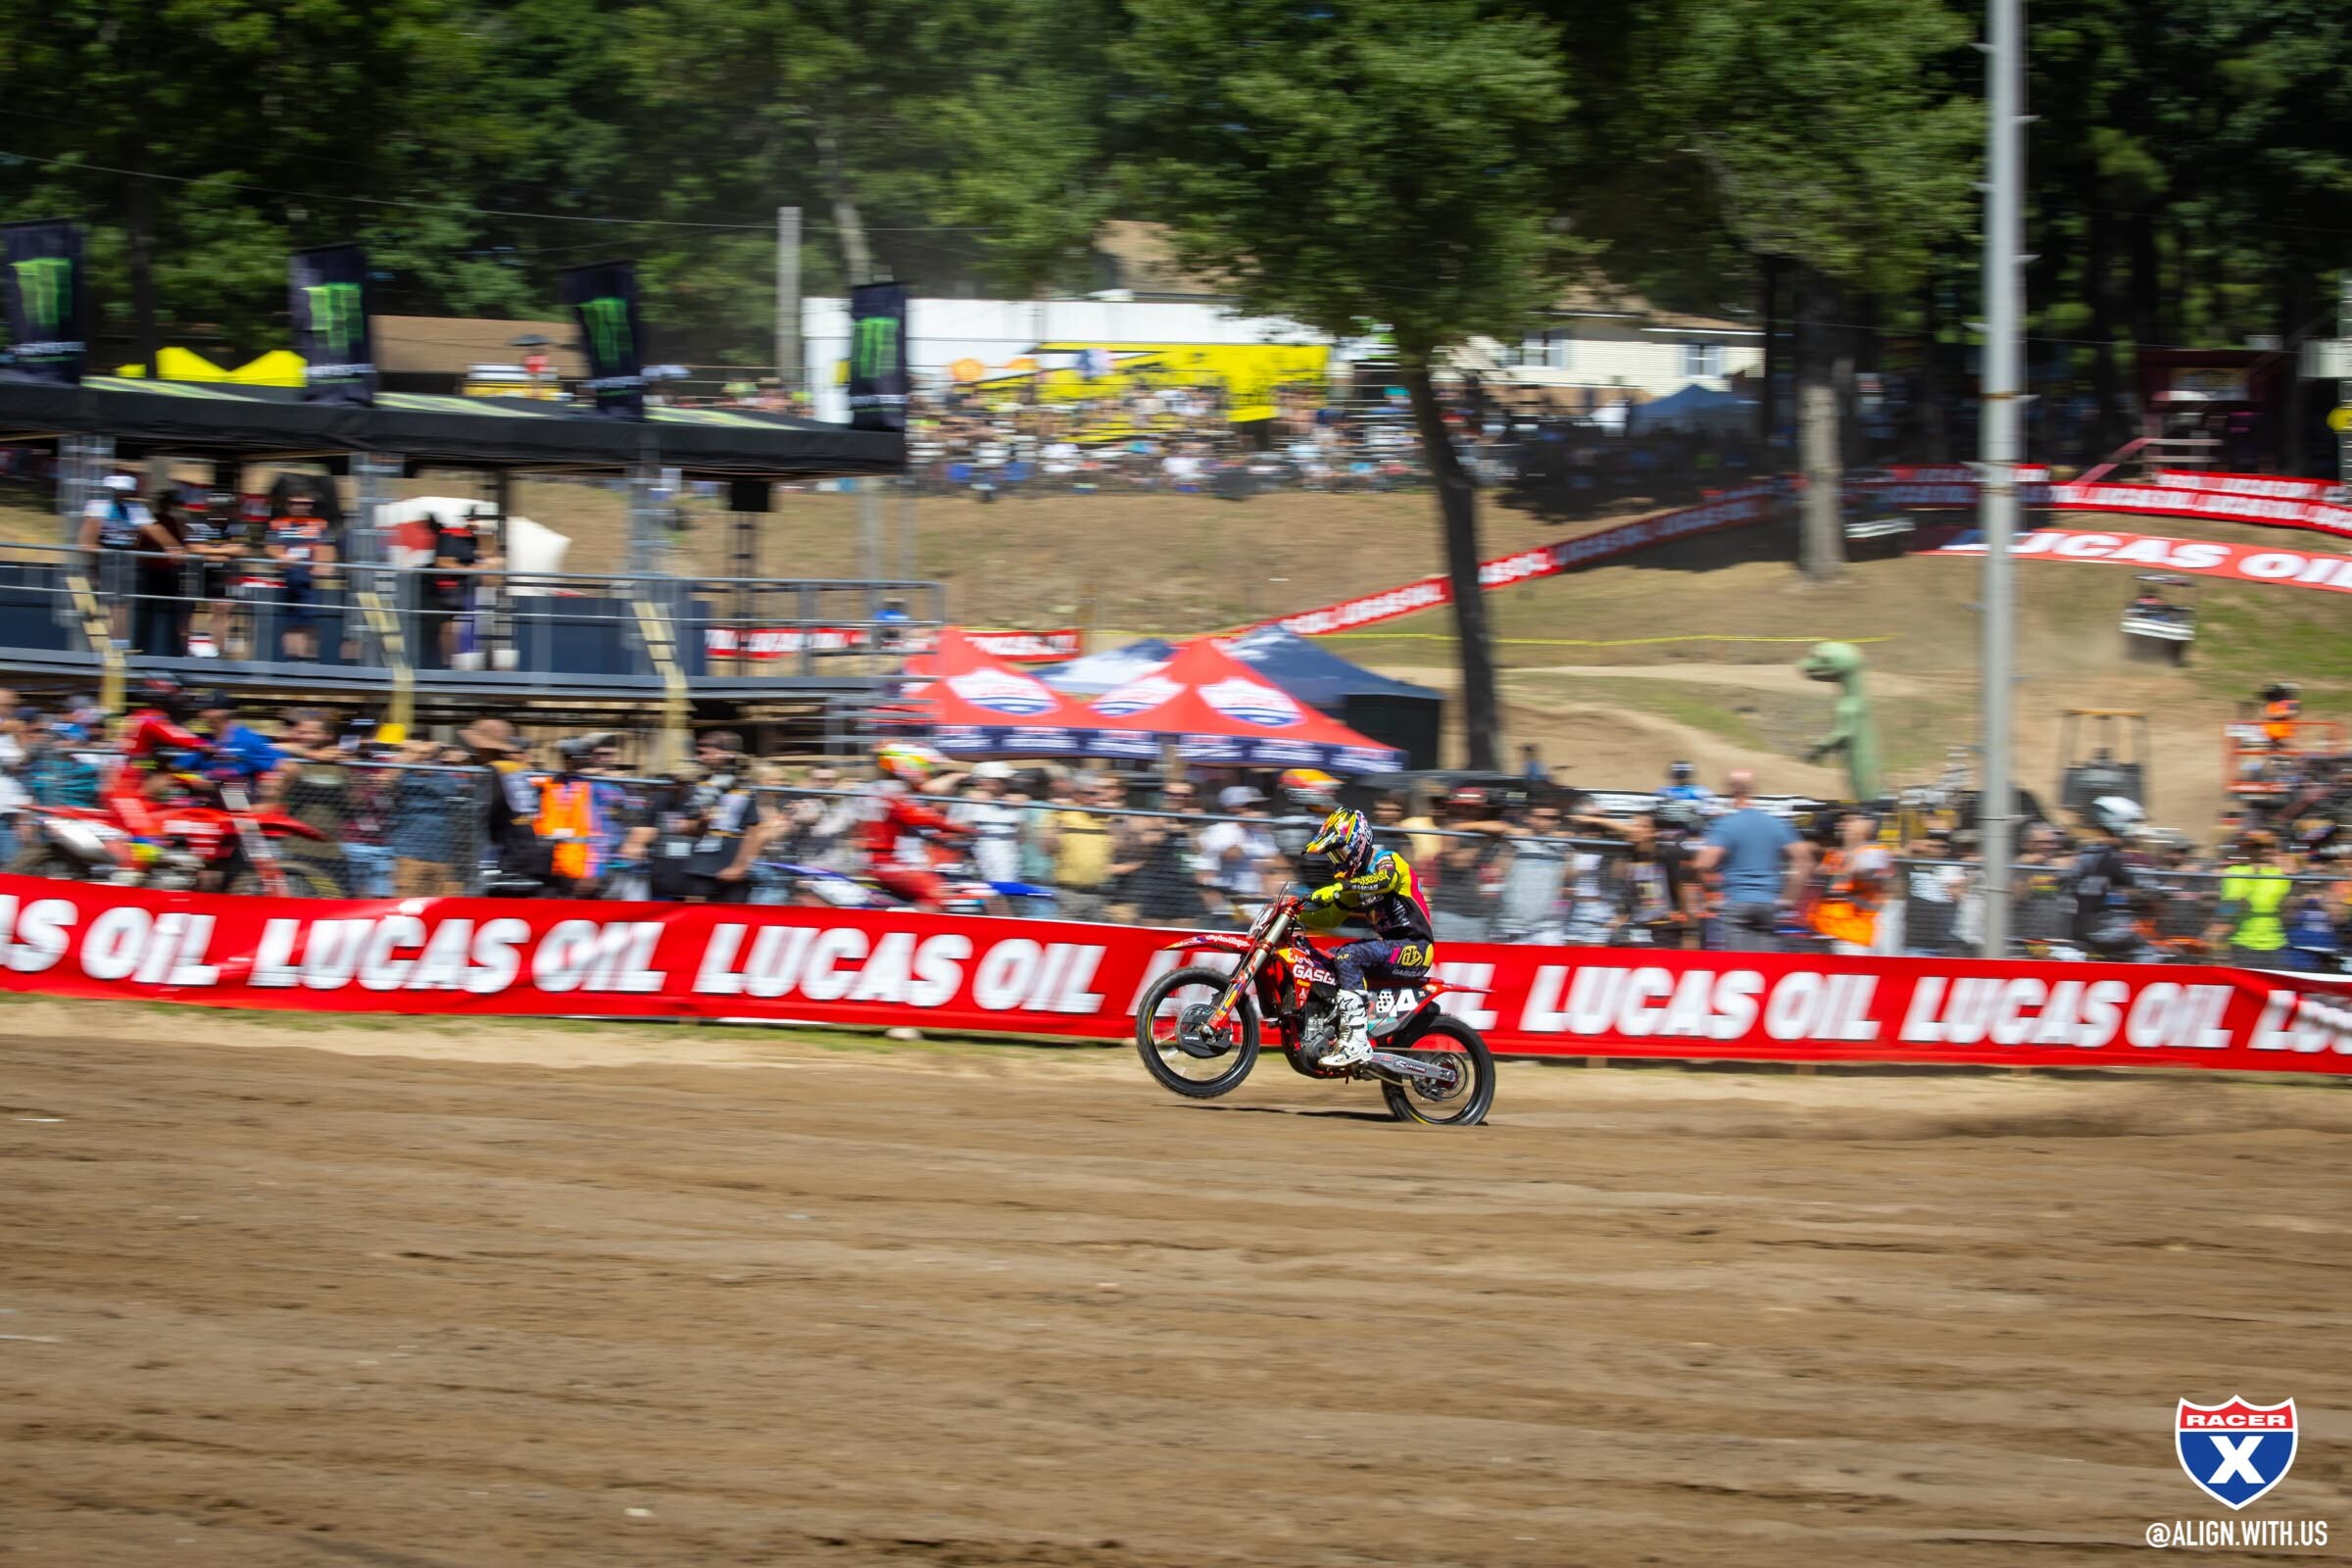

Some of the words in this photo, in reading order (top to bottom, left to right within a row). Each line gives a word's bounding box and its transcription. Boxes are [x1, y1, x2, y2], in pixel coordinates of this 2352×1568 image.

[80, 906, 220, 985] OIL
[247, 915, 530, 993] LUCAS
[532, 920, 666, 991] OIL
[692, 924, 973, 1006] LUCAS
[973, 938, 1105, 1012] OIL
[1519, 965, 1764, 1040] LUCAS
[1765, 972, 1881, 1041] OIL
[1899, 976, 2128, 1048] LUCAS
[2127, 983, 2233, 1048] OIL
